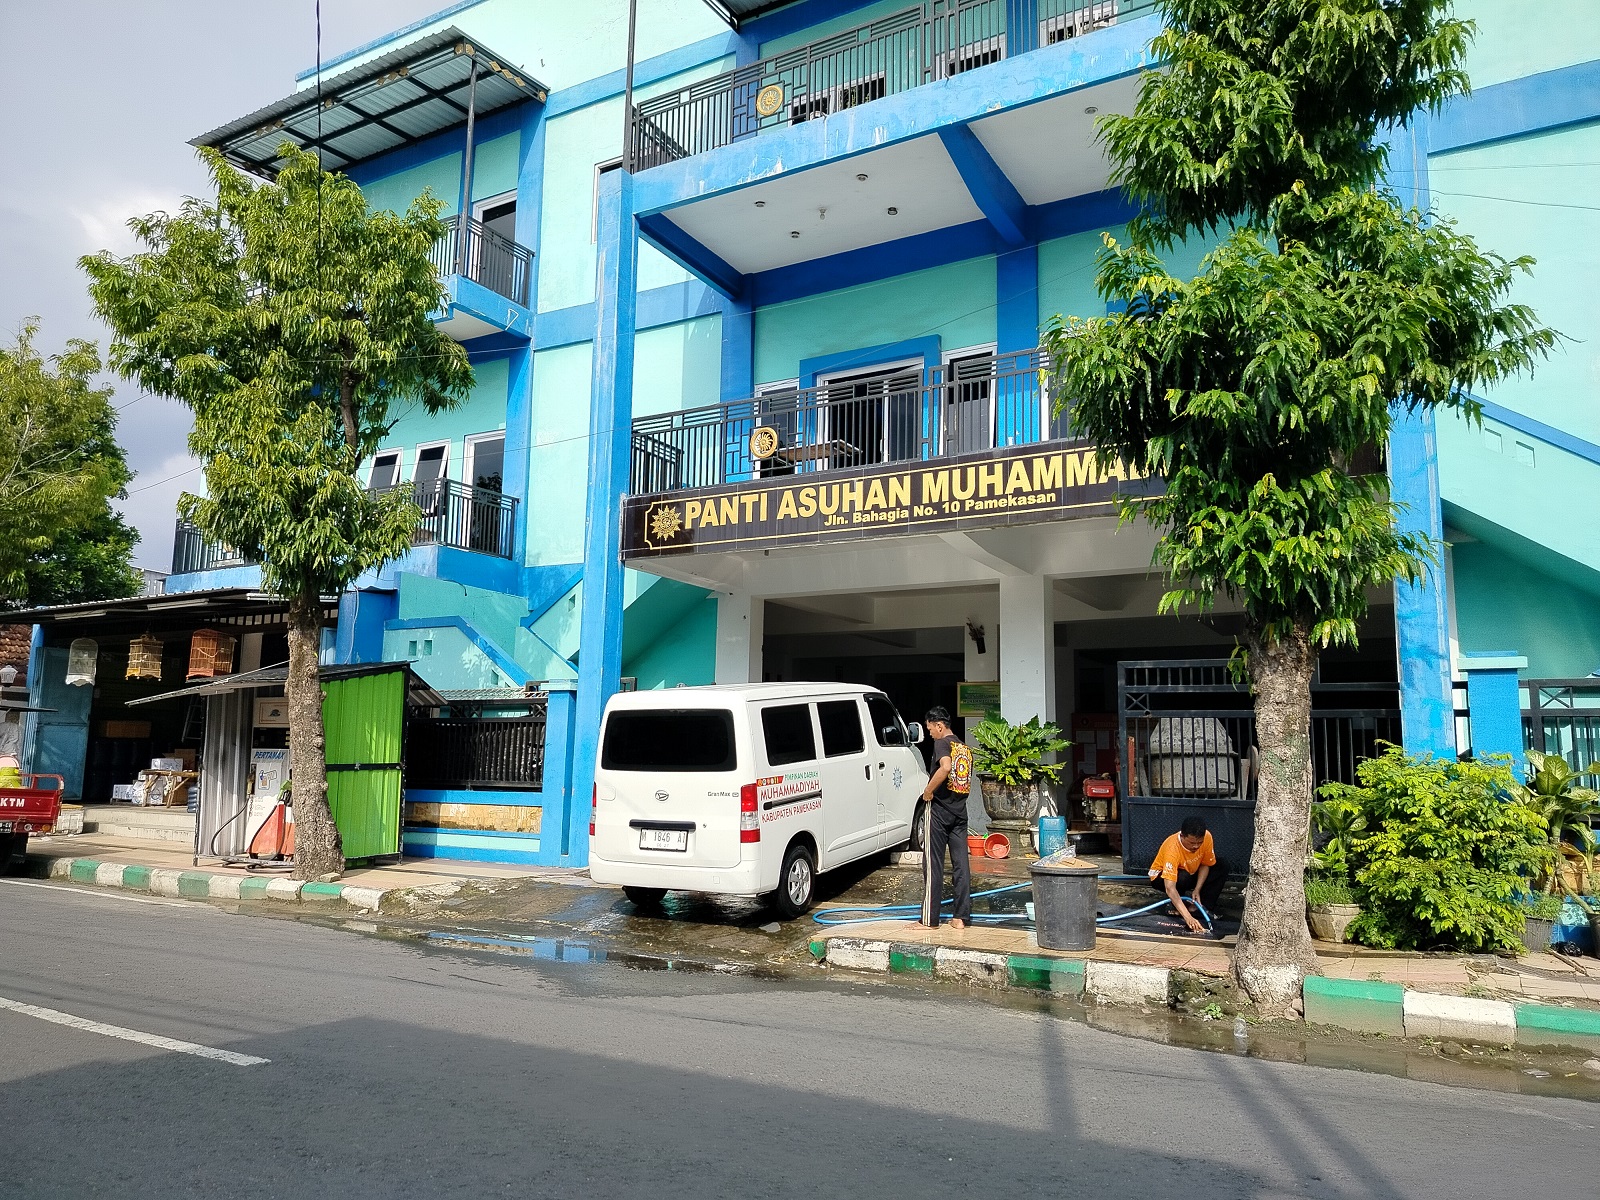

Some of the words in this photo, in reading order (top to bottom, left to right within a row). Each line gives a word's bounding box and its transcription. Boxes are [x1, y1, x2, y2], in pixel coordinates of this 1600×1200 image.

[684, 492, 768, 529] PANTI
[777, 475, 911, 520] ASUHAN
[824, 513, 848, 527] Jln.
[852, 508, 910, 523] Bahagia
[913, 505, 938, 516] No.
[942, 501, 960, 513] 10
[965, 491, 1056, 512] Pamekasan
[253, 751, 286, 761] PERTAMAX
[760, 780, 820, 801] MUHAMMADIYAH
[0, 798, 25, 807] KTM
[761, 808, 793, 823] KABUPATEN
[793, 800, 822, 816] PAMEKASAN
[654, 831, 671, 843] 1846
